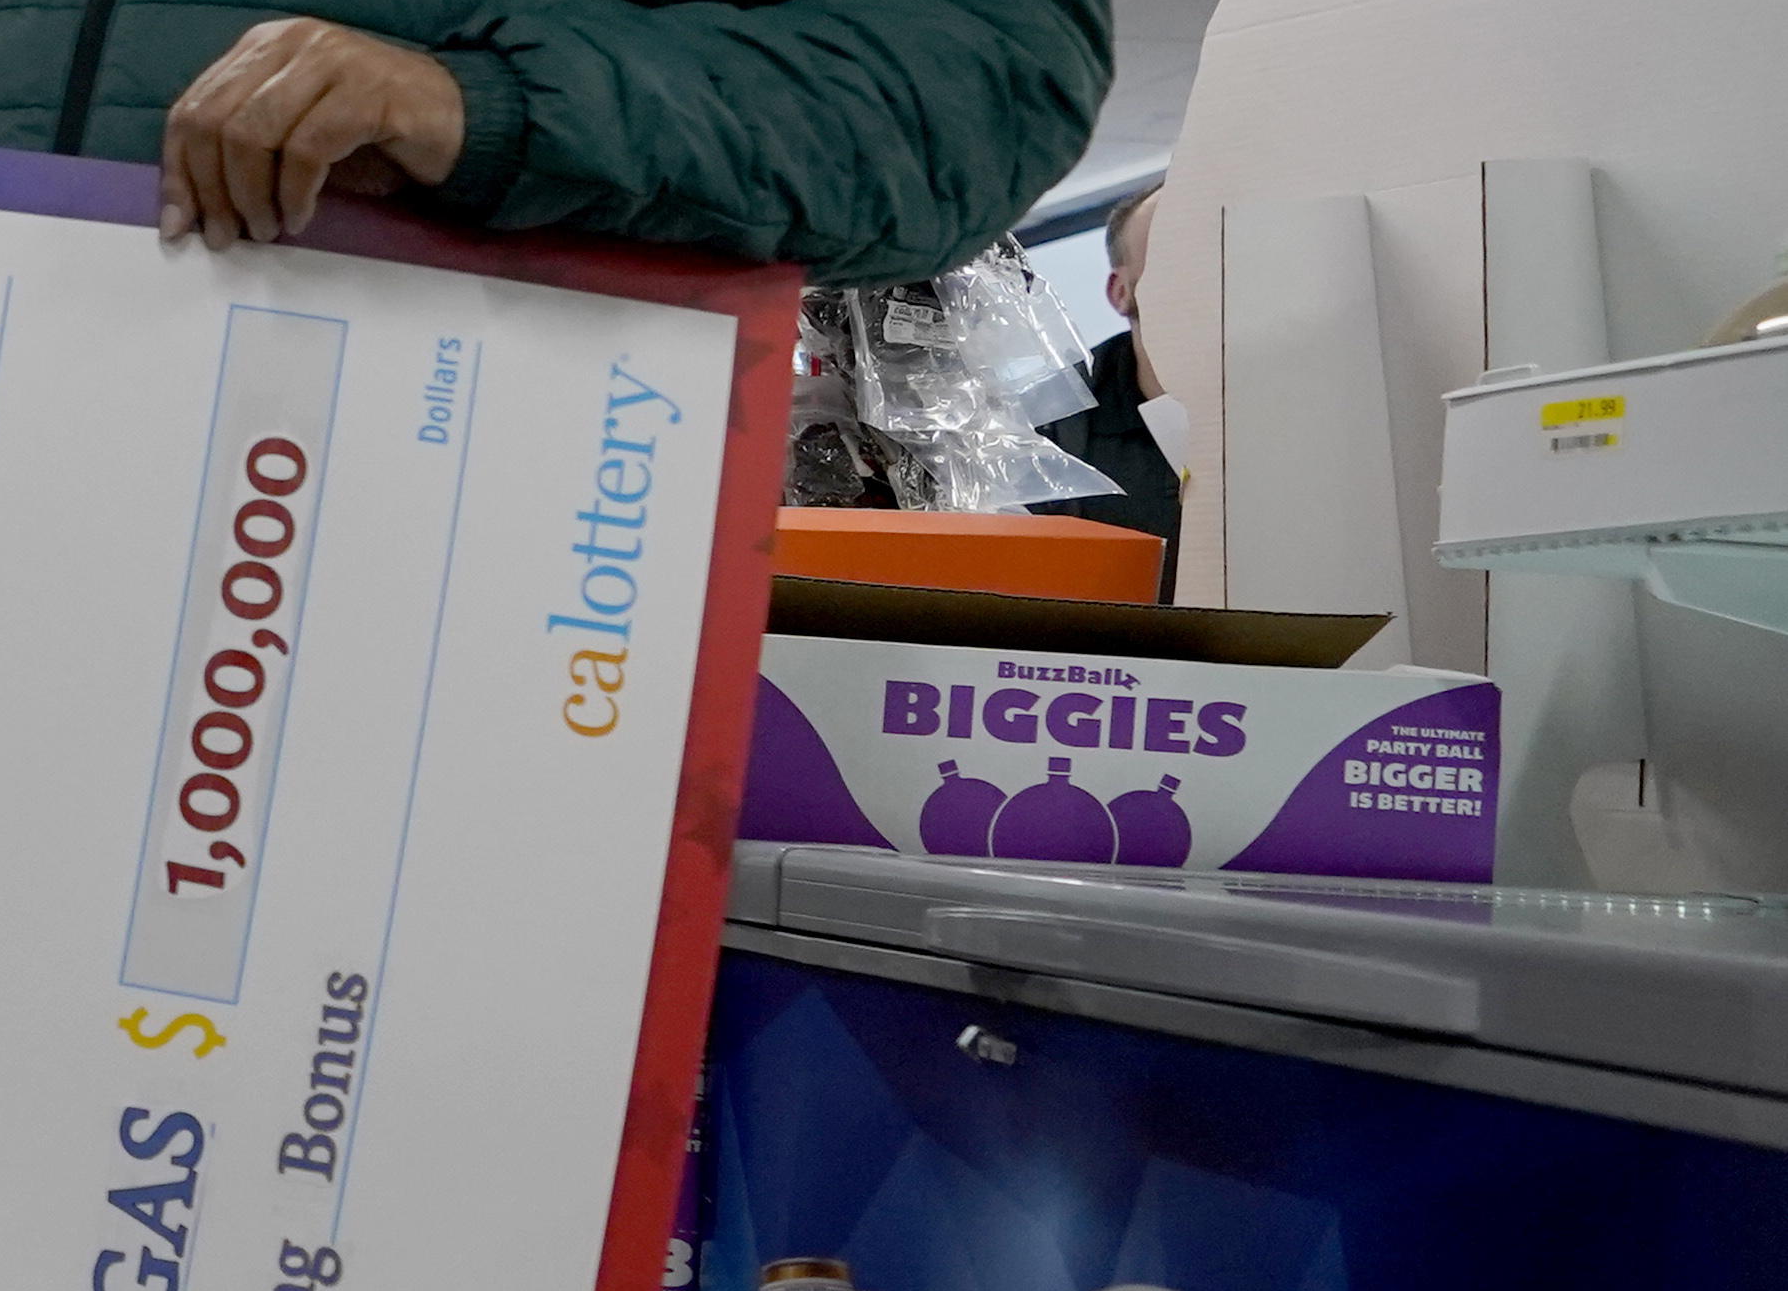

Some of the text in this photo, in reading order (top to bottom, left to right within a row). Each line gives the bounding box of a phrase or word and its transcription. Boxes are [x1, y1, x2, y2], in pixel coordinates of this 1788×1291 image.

[417, 337, 463, 444] Dollars
[546, 360, 682, 738] calottery
[996, 660, 1141, 690] BuzzBallz
[118, 436, 309, 1058] $ 1,000,000
[882, 680, 1248, 758] BIGGIES
[1391, 726, 1485, 741] THE ULTIMATE
[1344, 759, 1483, 793] BIGGER
[1367, 739, 1483, 760] PARTY BALL
[1350, 791, 1482, 817] IS BETTER!
[278, 970, 369, 1182] Bonus
